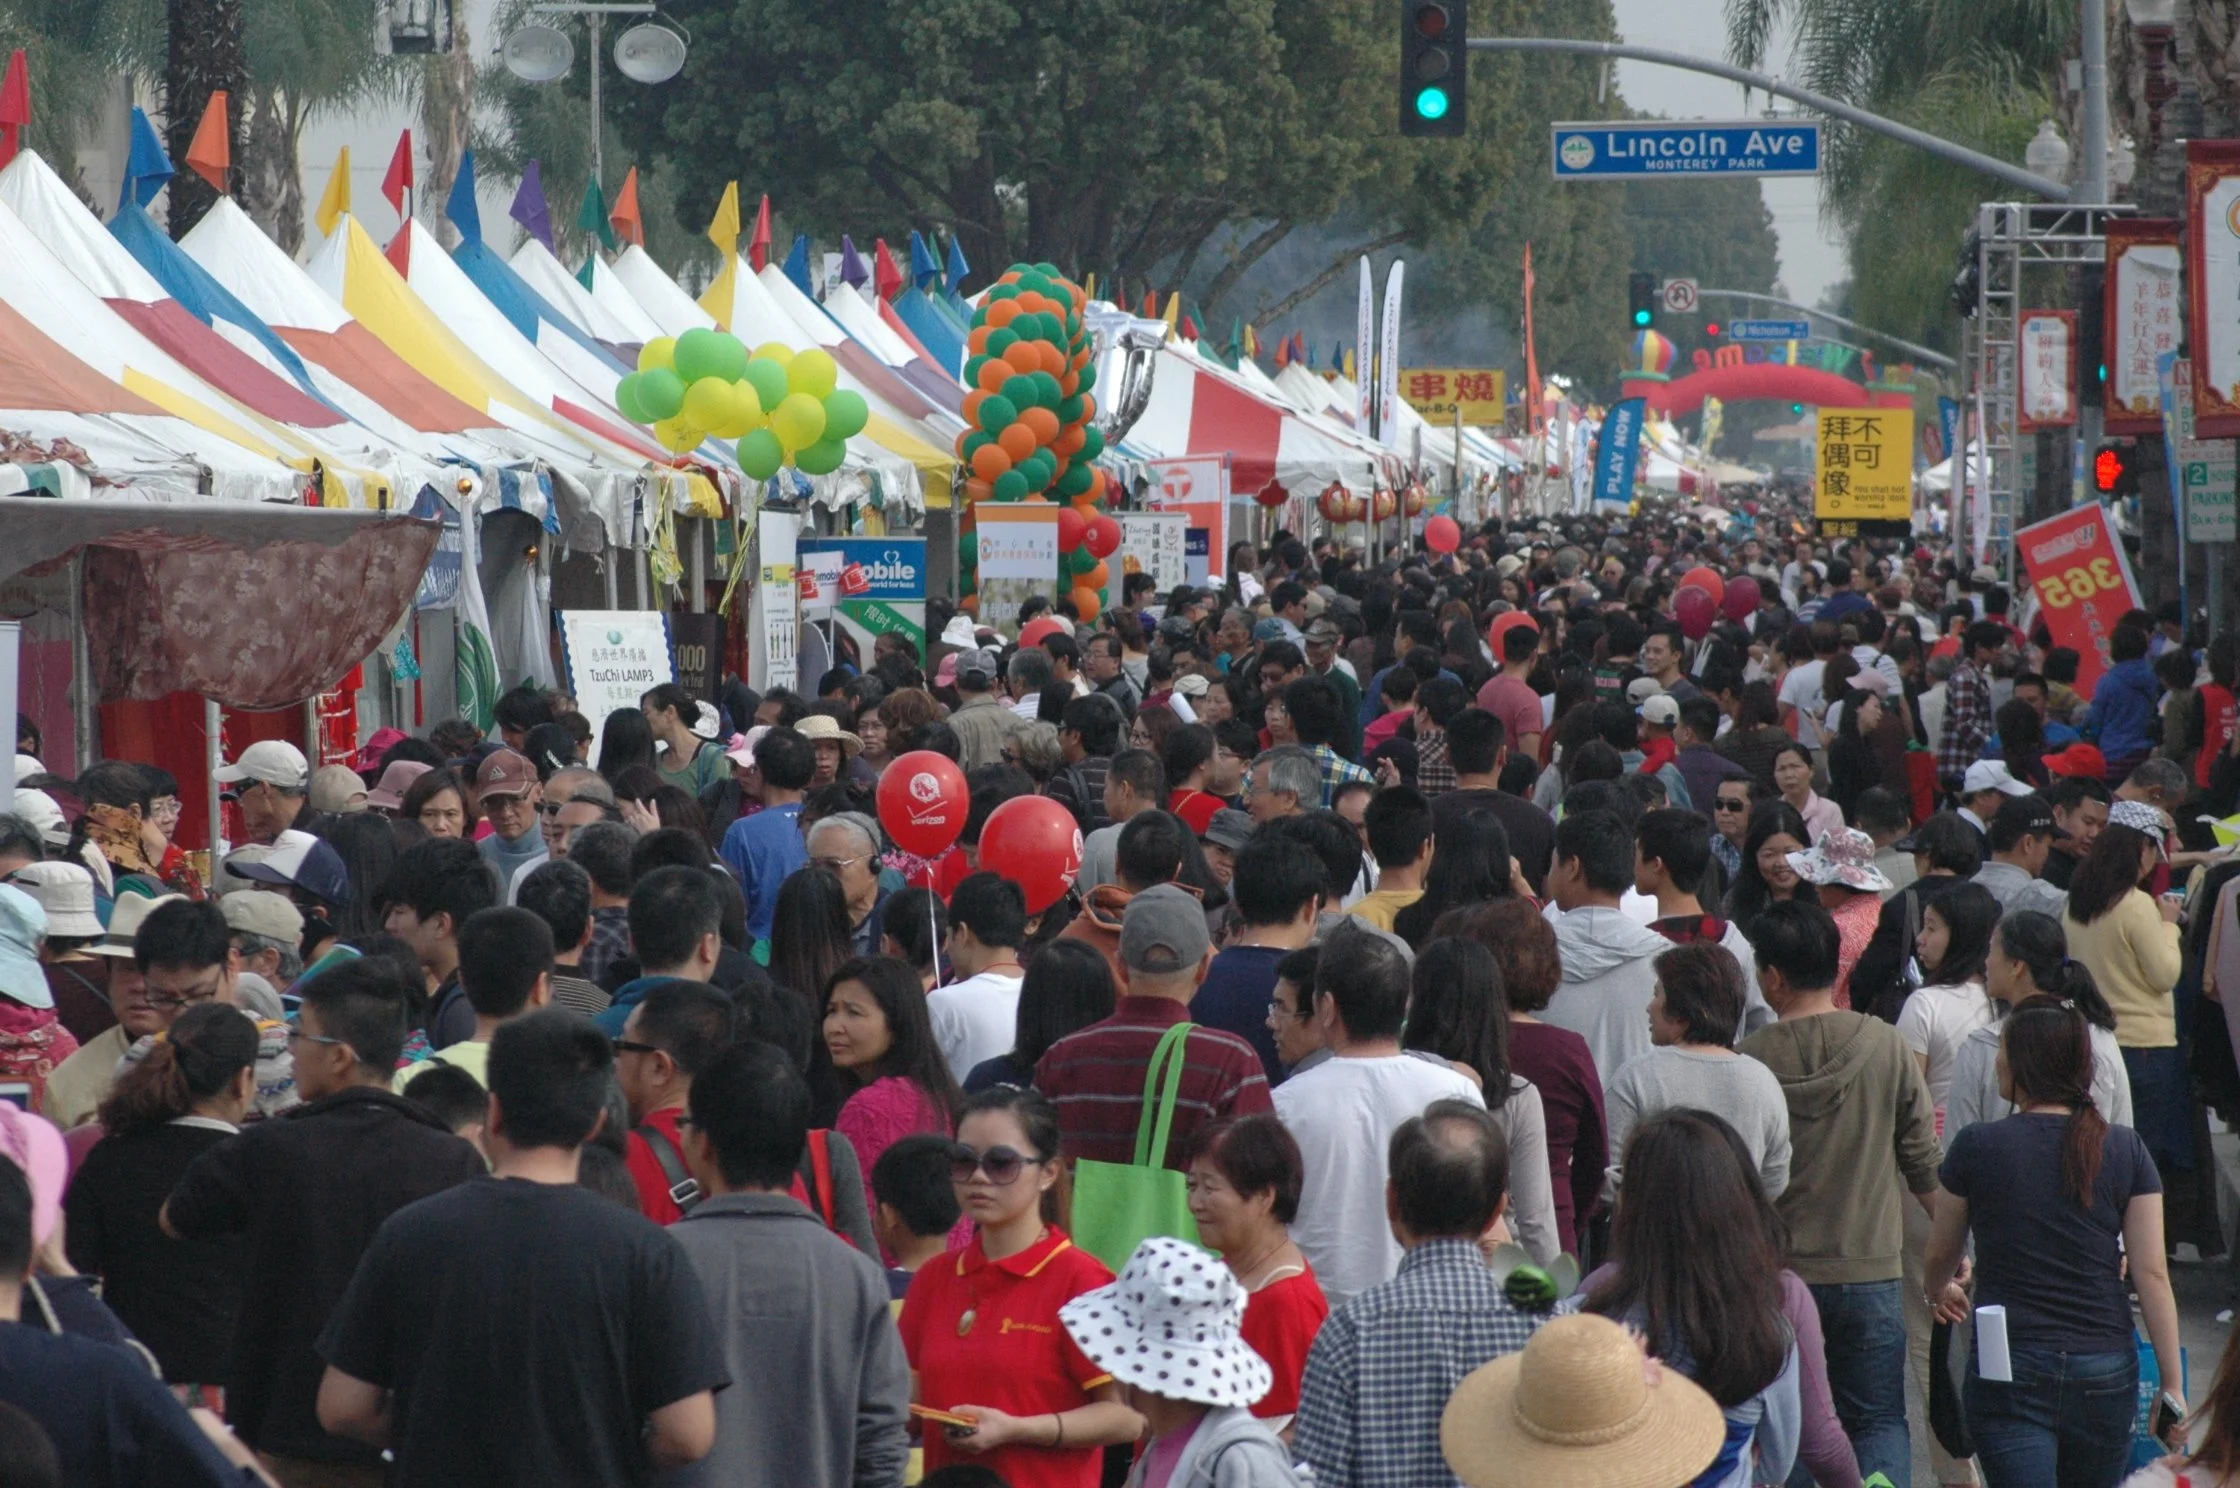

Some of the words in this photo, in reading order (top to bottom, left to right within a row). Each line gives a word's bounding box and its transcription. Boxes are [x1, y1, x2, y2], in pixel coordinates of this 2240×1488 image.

[1607, 131, 1727, 158] Lincoln
[1744, 130, 1803, 156] Ave
[1645, 159, 1718, 171] MONTEREY
[1728, 158, 1765, 169] PARK
[1613, 407, 1632, 447] NOW
[1852, 416, 1882, 470] 不可
[1606, 450, 1628, 494] PLAY
[2191, 464, 2204, 483] 2
[863, 560, 916, 580] obile
[589, 668, 621, 682] TzuChi
[621, 668, 655, 682] LAMP3
[911, 815, 946, 826] verizon
